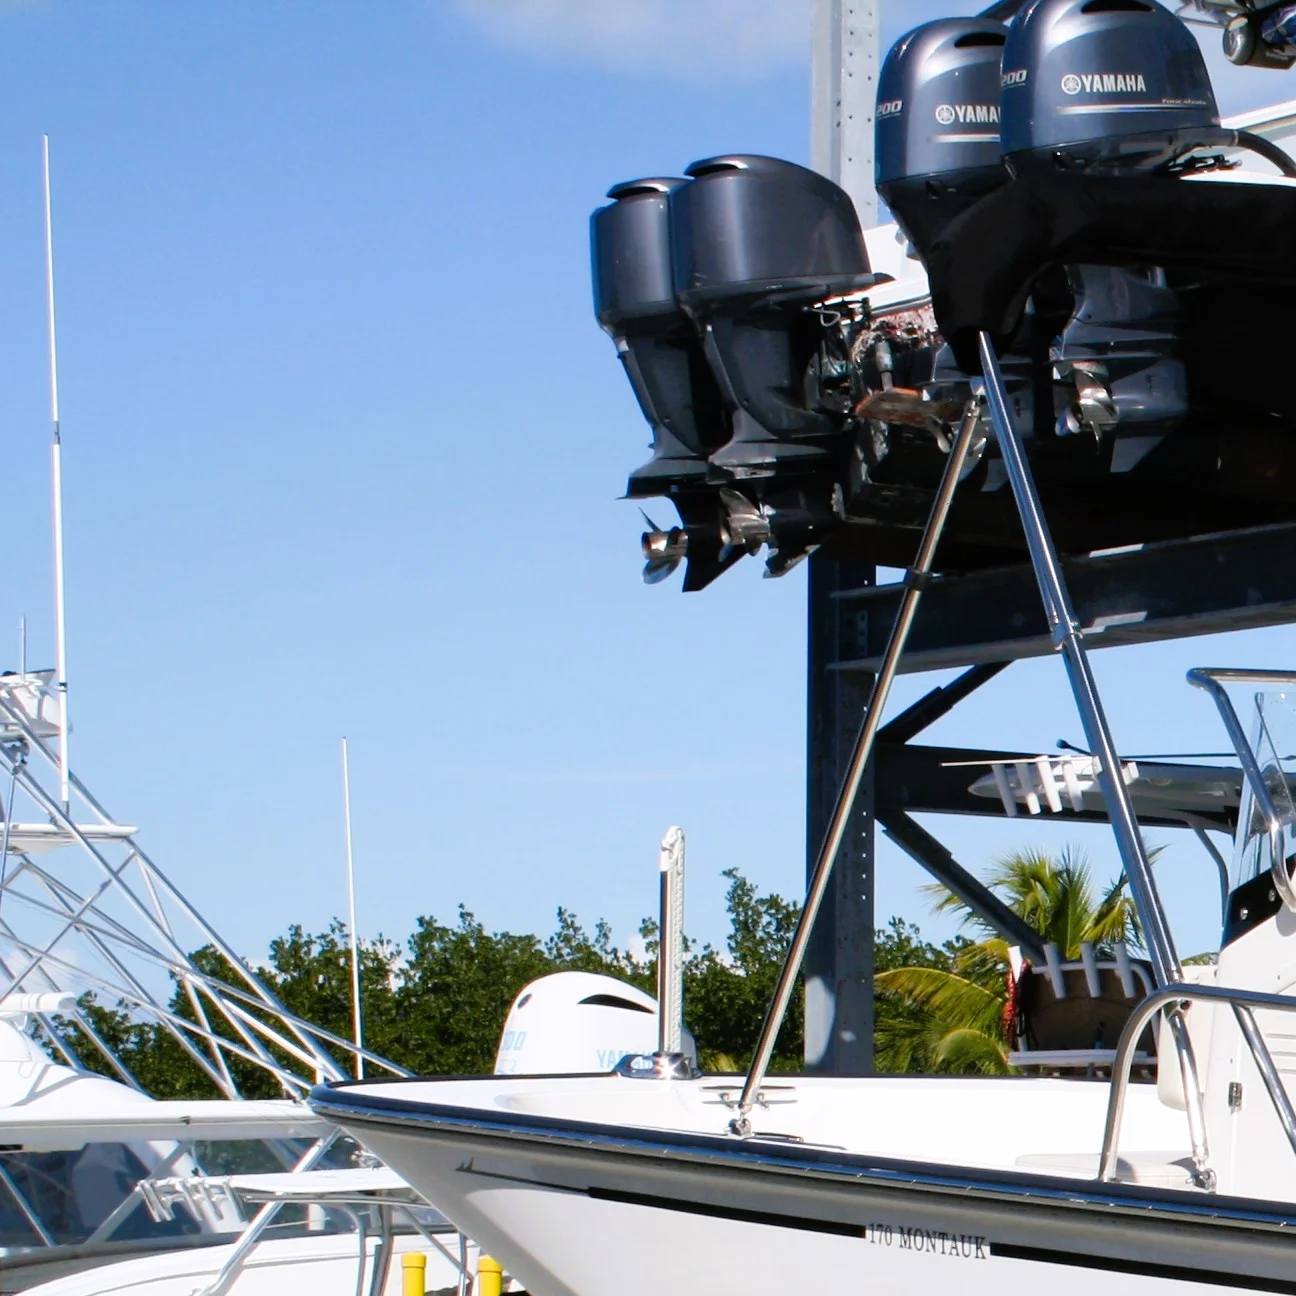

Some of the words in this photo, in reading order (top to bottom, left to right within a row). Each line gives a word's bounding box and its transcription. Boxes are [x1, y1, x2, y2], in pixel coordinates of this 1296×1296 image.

[1082, 74, 1147, 92] YAMAHA
[955, 104, 1000, 123] YAMA
[870, 1223, 893, 1247] 170
[899, 1225, 987, 1260] MONTAUK
